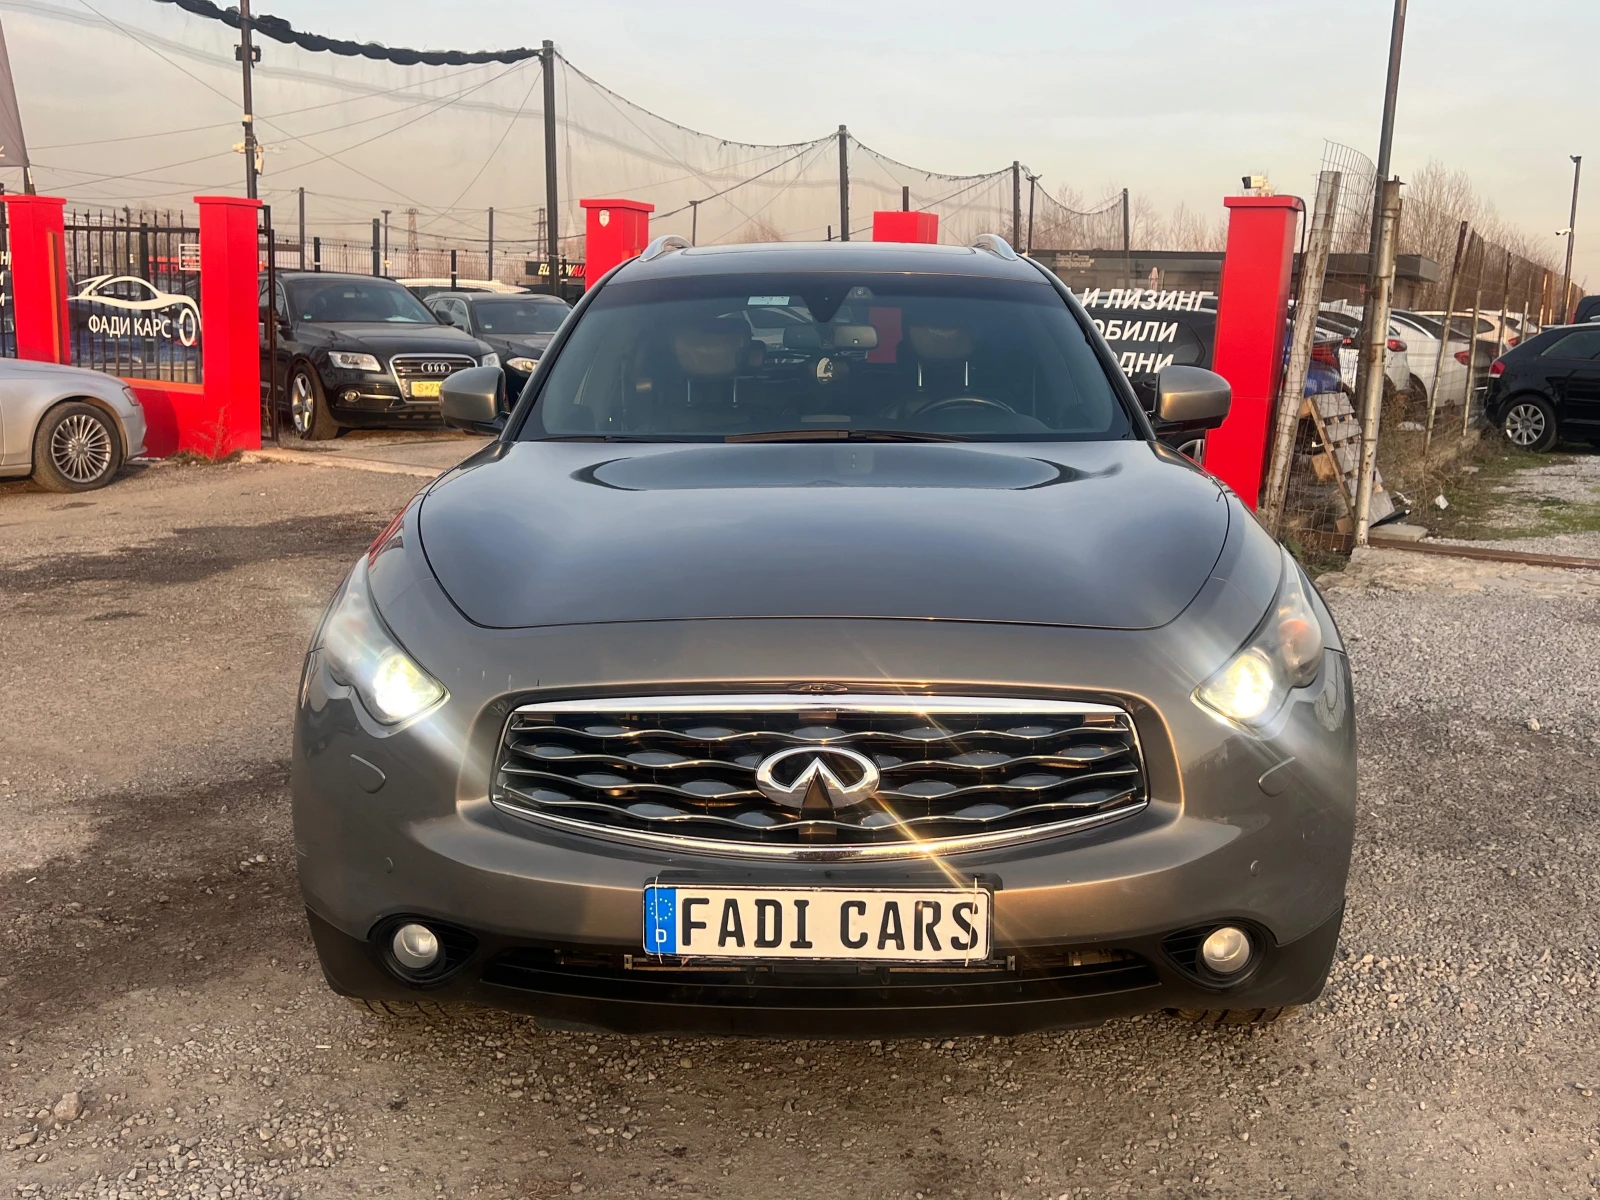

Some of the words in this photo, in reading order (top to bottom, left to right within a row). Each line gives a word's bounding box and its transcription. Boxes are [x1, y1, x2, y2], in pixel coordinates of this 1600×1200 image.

[1081, 287, 1101, 308] И
[1103, 288, 1214, 312] ЛИЗИНГ
[88, 314, 131, 338] ФАДИ
[134, 317, 172, 338] КАРС
[681, 897, 813, 949] FADI
[839, 900, 979, 951] CARS
